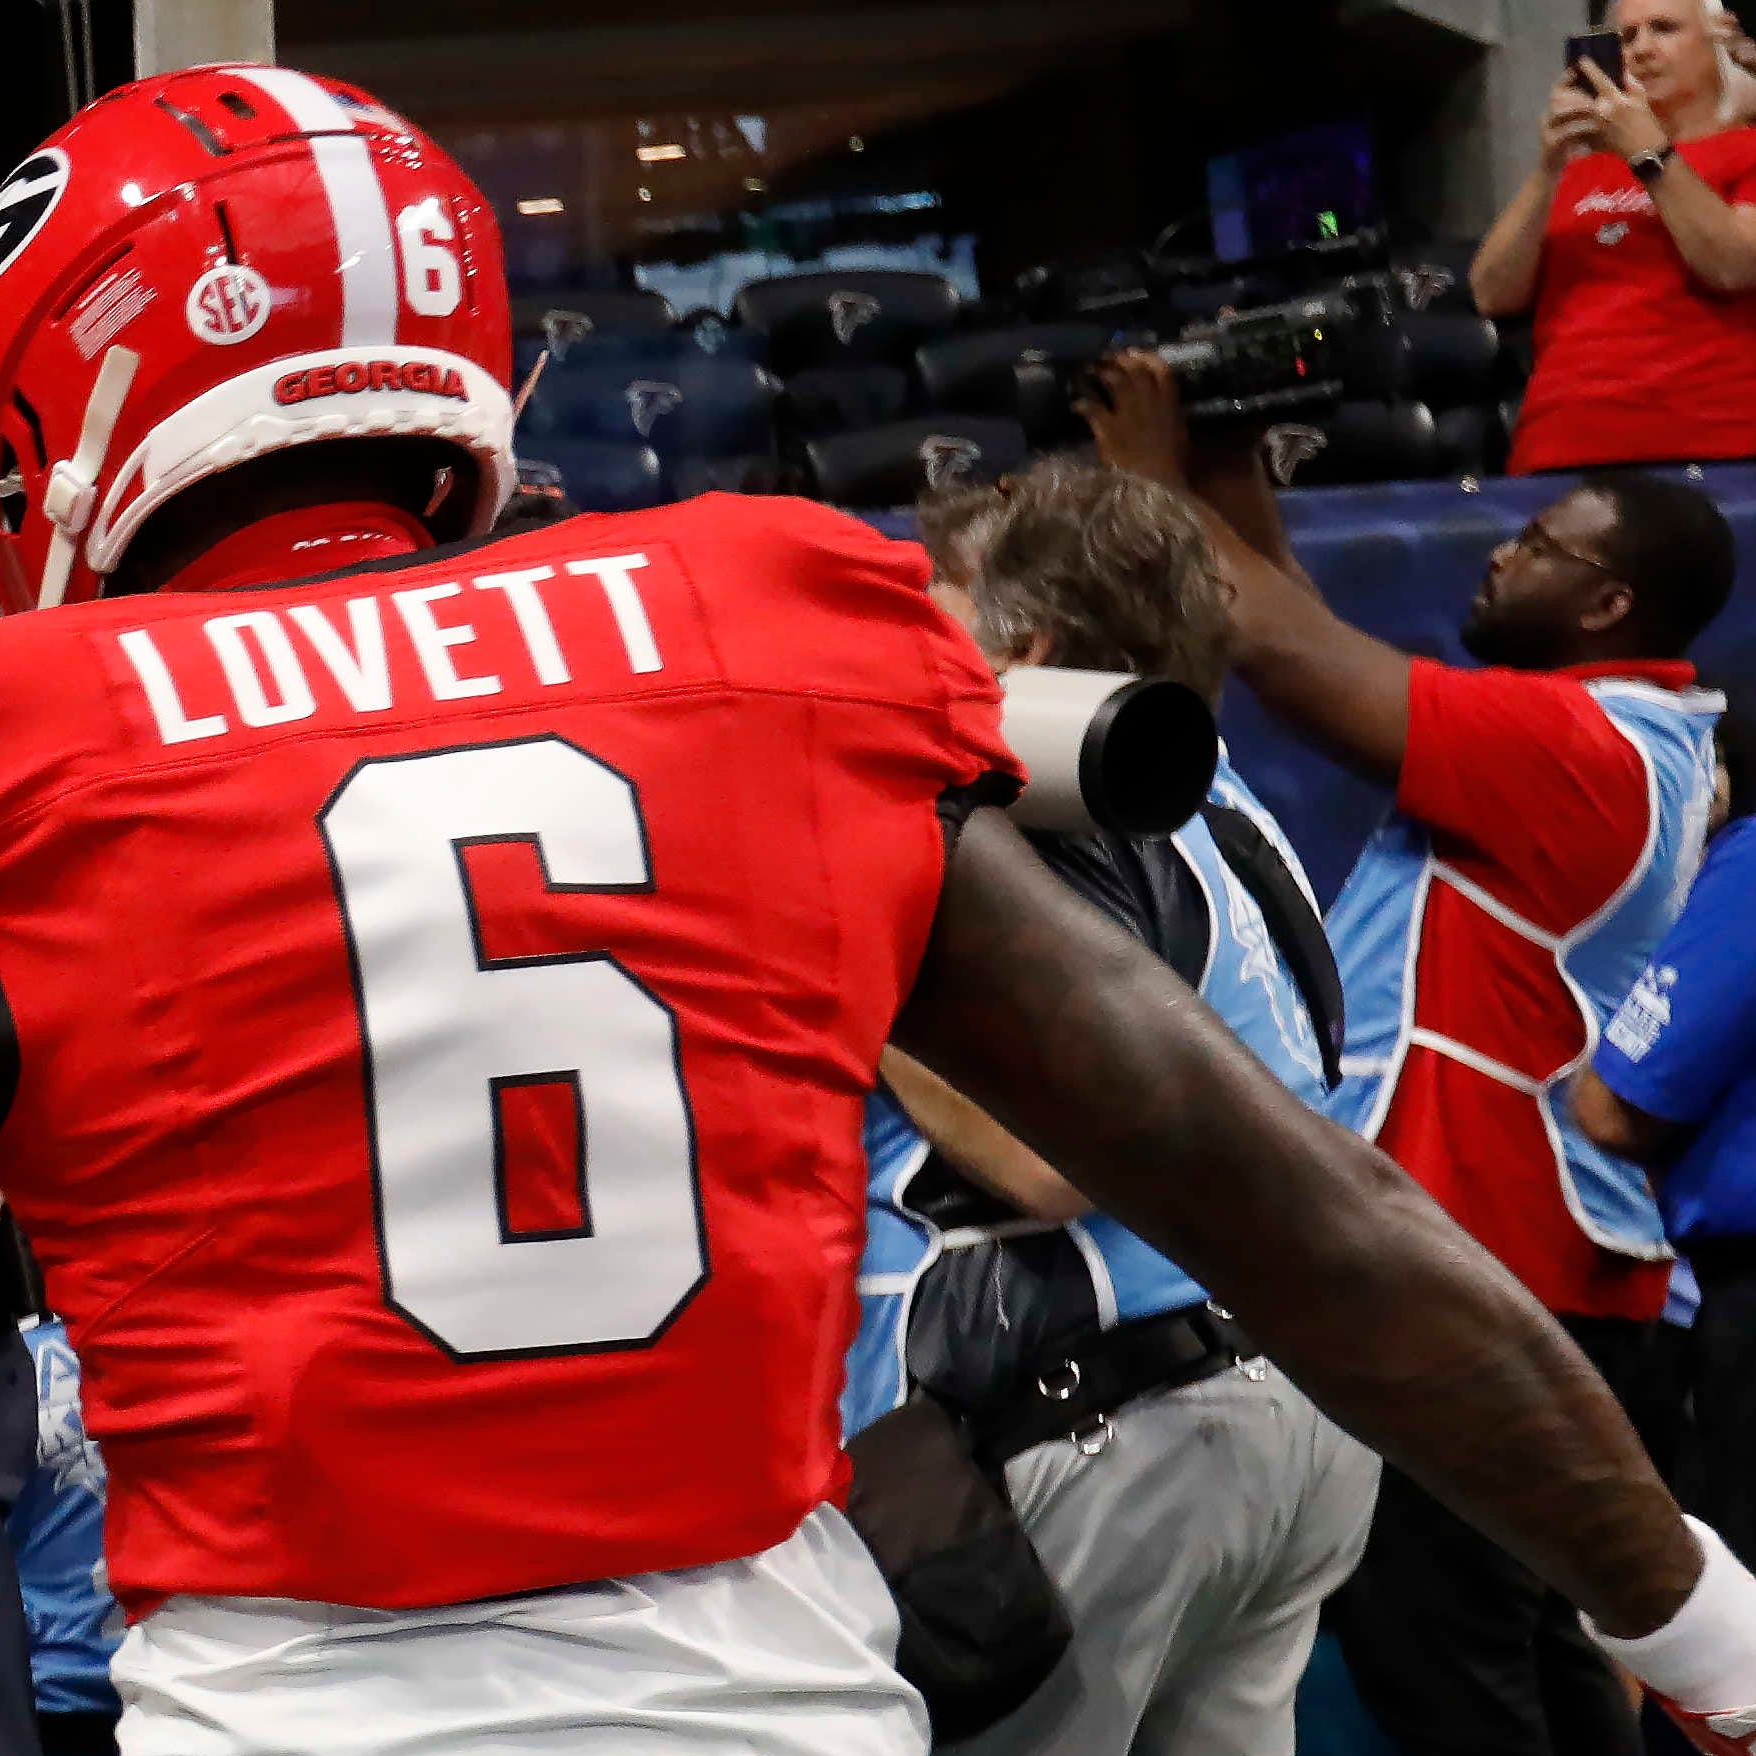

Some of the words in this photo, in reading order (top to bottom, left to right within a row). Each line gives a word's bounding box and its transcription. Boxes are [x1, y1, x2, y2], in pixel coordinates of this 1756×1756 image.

[196, 272, 262, 335] SEC
[396, 196, 464, 317] 6
[272, 359, 471, 406] GEORGIA
[118, 552, 664, 746] LOVETT
[317, 733, 709, 1363] 6
